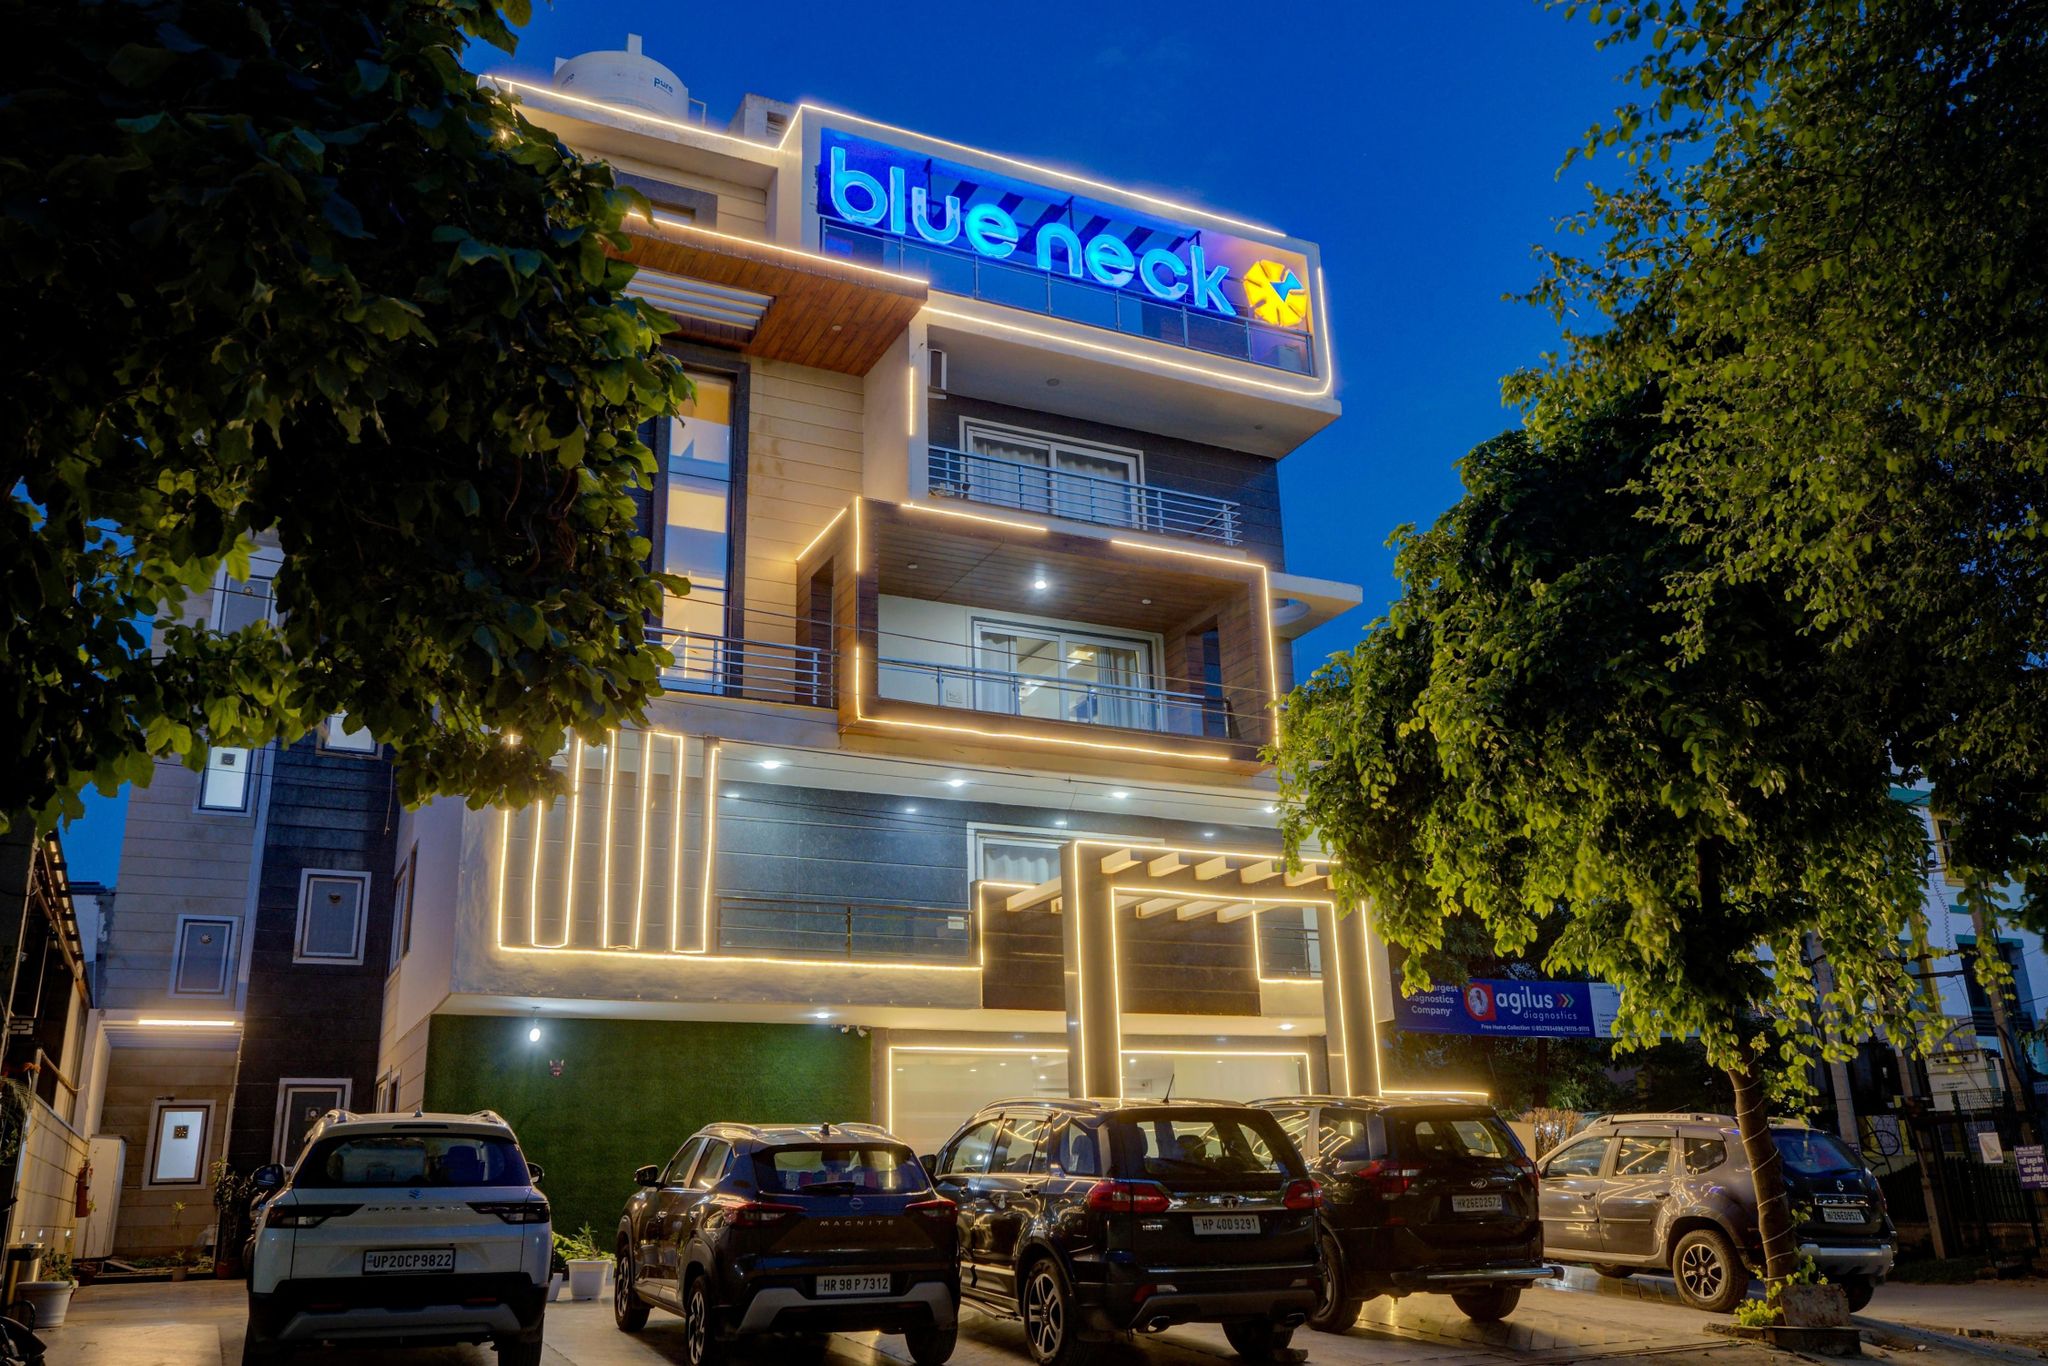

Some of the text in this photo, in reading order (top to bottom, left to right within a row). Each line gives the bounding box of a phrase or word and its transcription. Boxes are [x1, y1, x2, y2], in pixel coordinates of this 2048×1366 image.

[830, 146, 1238, 318] blue neck
[1496, 986, 1554, 1015] agilus
[1523, 1010, 1577, 1021] diagnostics
[1480, 1023, 1492, 1031] Free
[1202, 1218, 1213, 1231] HP
[373, 1254, 452, 1268] UP20CP9822
[823, 1278, 888, 1291] HR 98 P 7312
